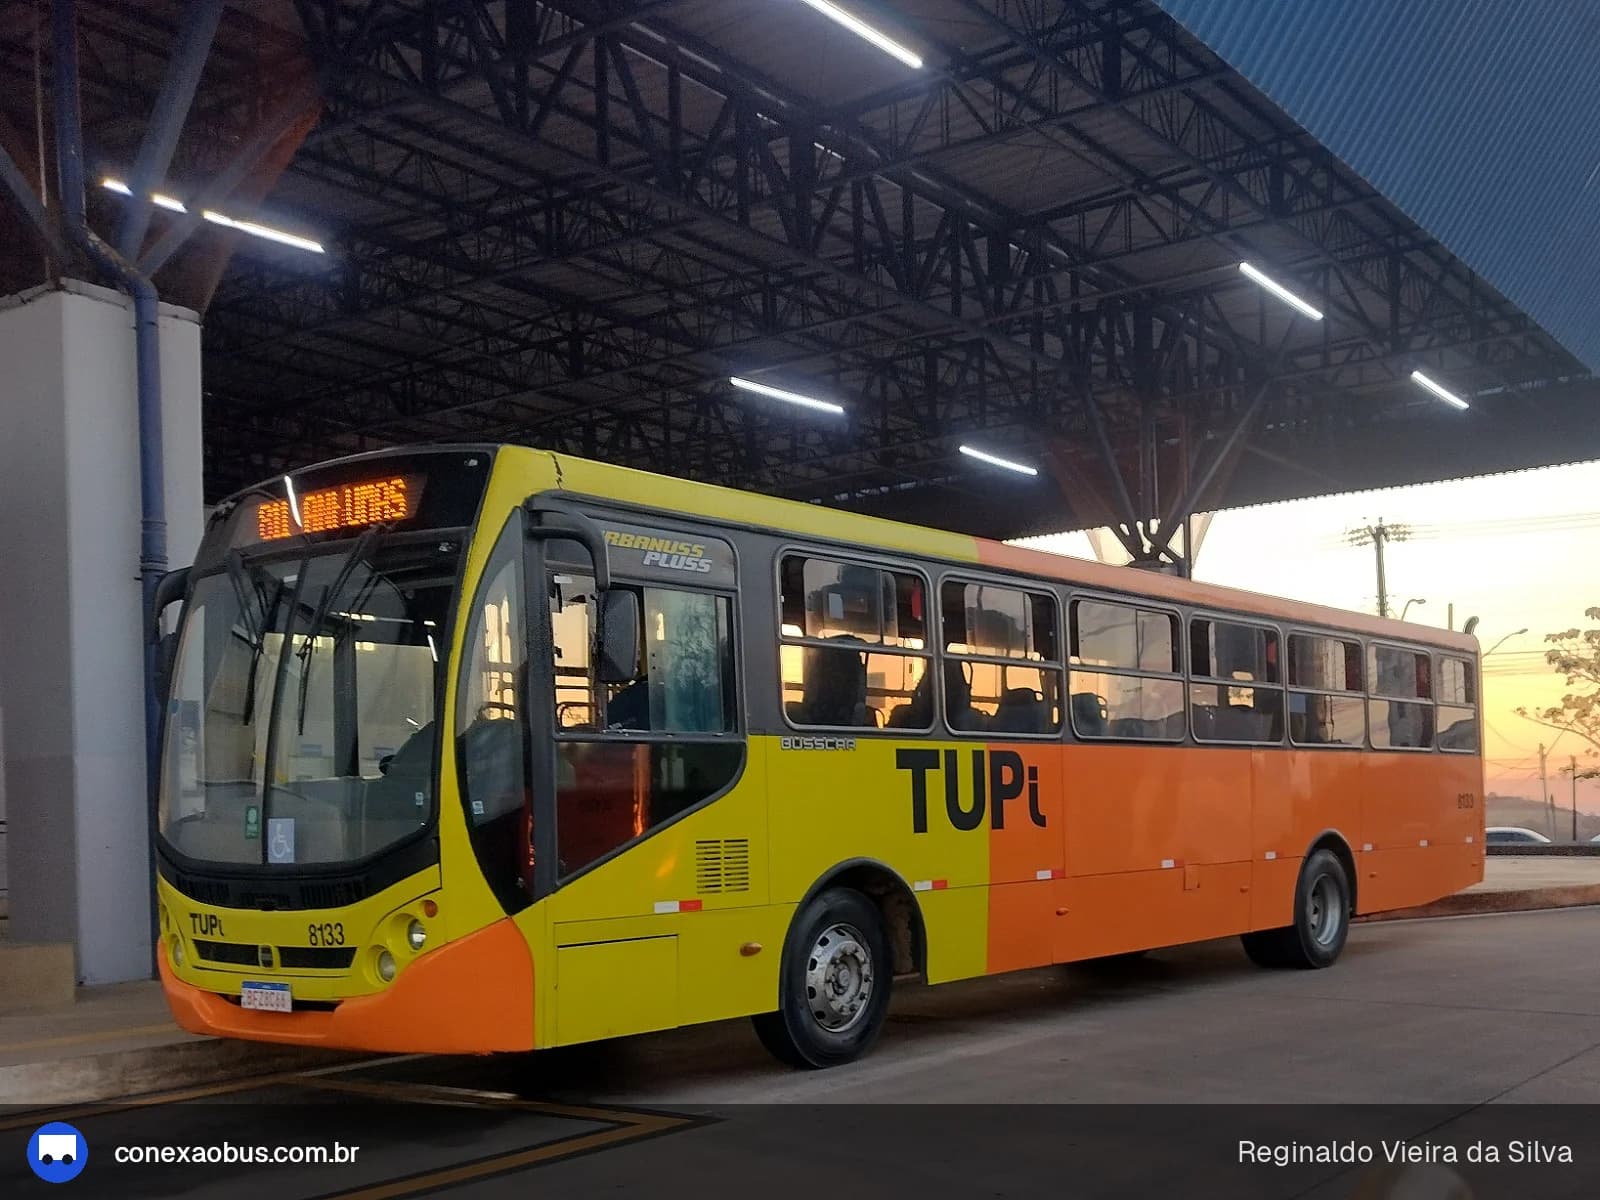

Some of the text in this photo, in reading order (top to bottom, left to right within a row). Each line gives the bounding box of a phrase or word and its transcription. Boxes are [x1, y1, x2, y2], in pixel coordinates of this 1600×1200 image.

[603, 530, 706, 557] RBANUSS
[643, 551, 713, 573] PLUSS
[780, 736, 857, 751] BUSSCAR
[1457, 792, 1474, 809] 8133
[308, 923, 345, 946] 8133
